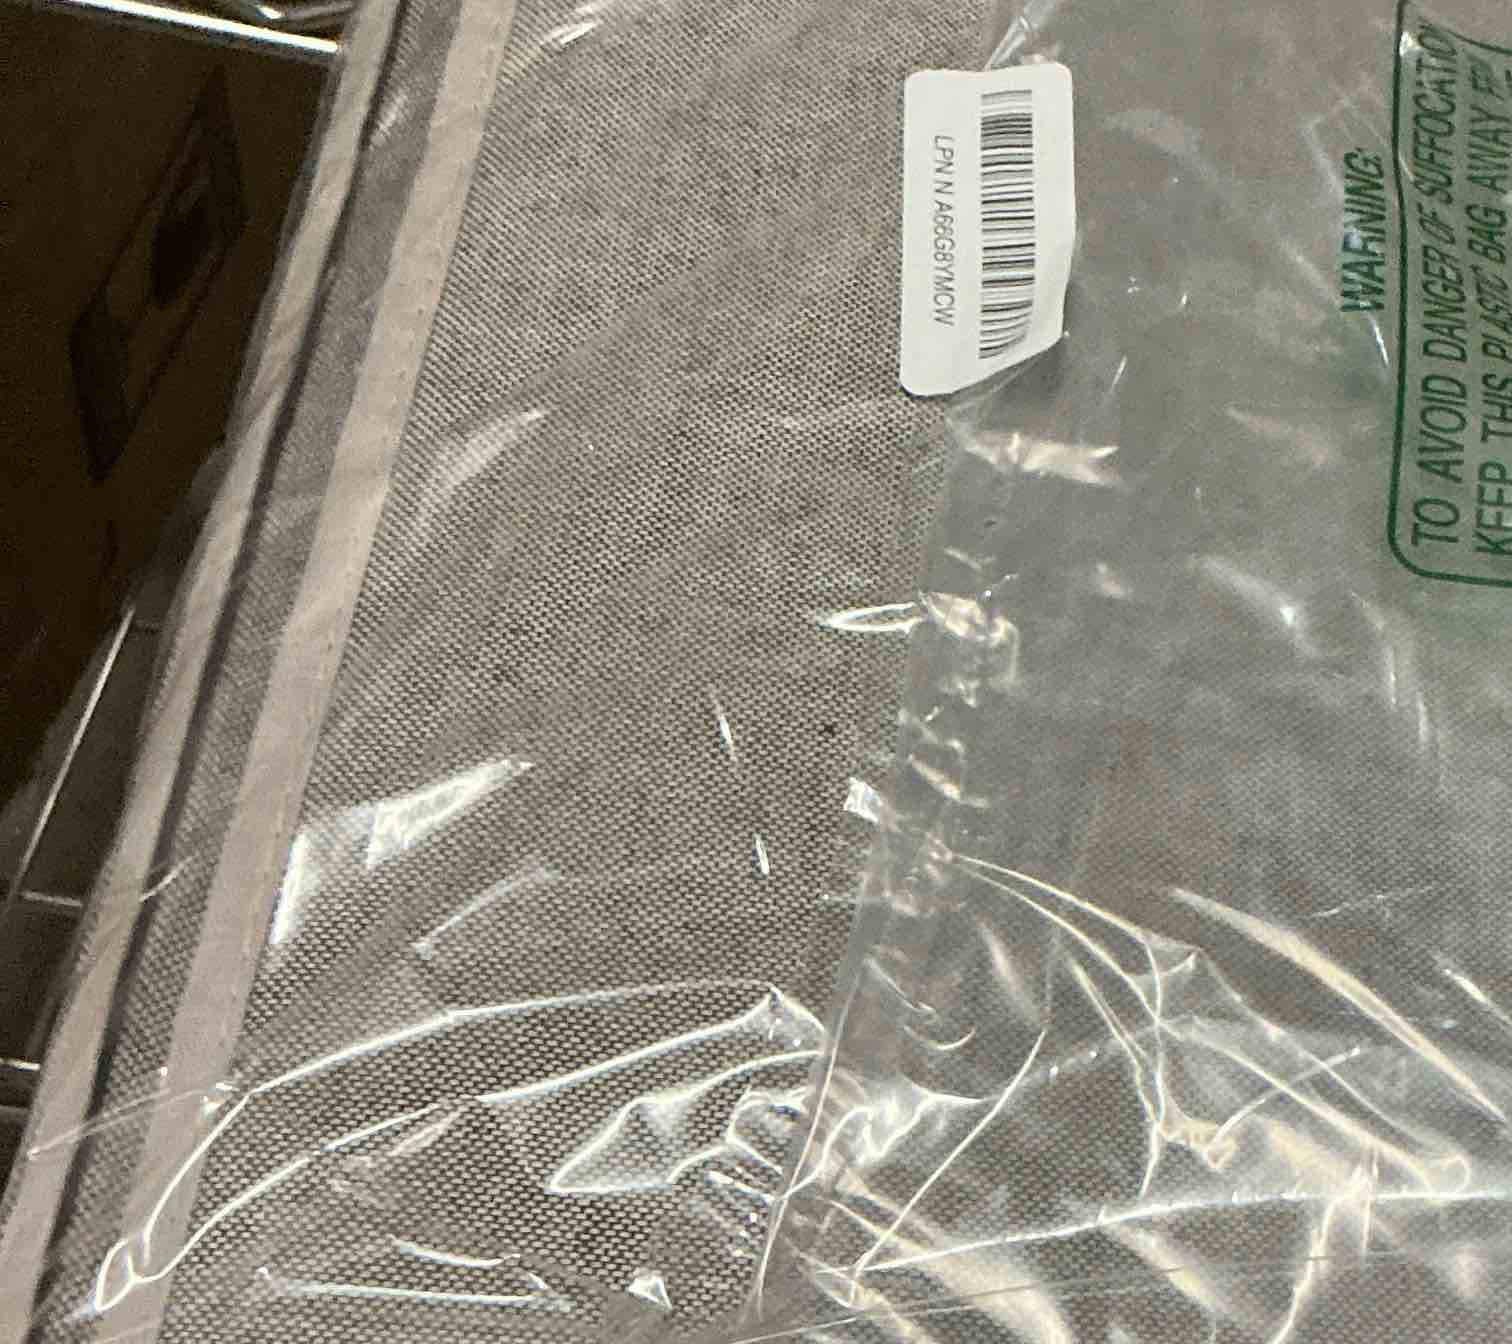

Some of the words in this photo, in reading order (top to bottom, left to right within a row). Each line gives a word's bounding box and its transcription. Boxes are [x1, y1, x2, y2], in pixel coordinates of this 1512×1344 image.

[932, 134, 956, 176] LPN
[932, 178, 956, 195] N
[1466, 105, 1512, 194] AWAY
[1340, 148, 1385, 312] WARNING:
[1417, 203, 1456, 246] OF
[1465, 205, 1508, 265] BAG
[932, 199, 956, 328] A66G8YMCW
[1421, 245, 1467, 363] DANGER
[1416, 374, 1467, 485] AVOID
[1411, 497, 1461, 547] TO
